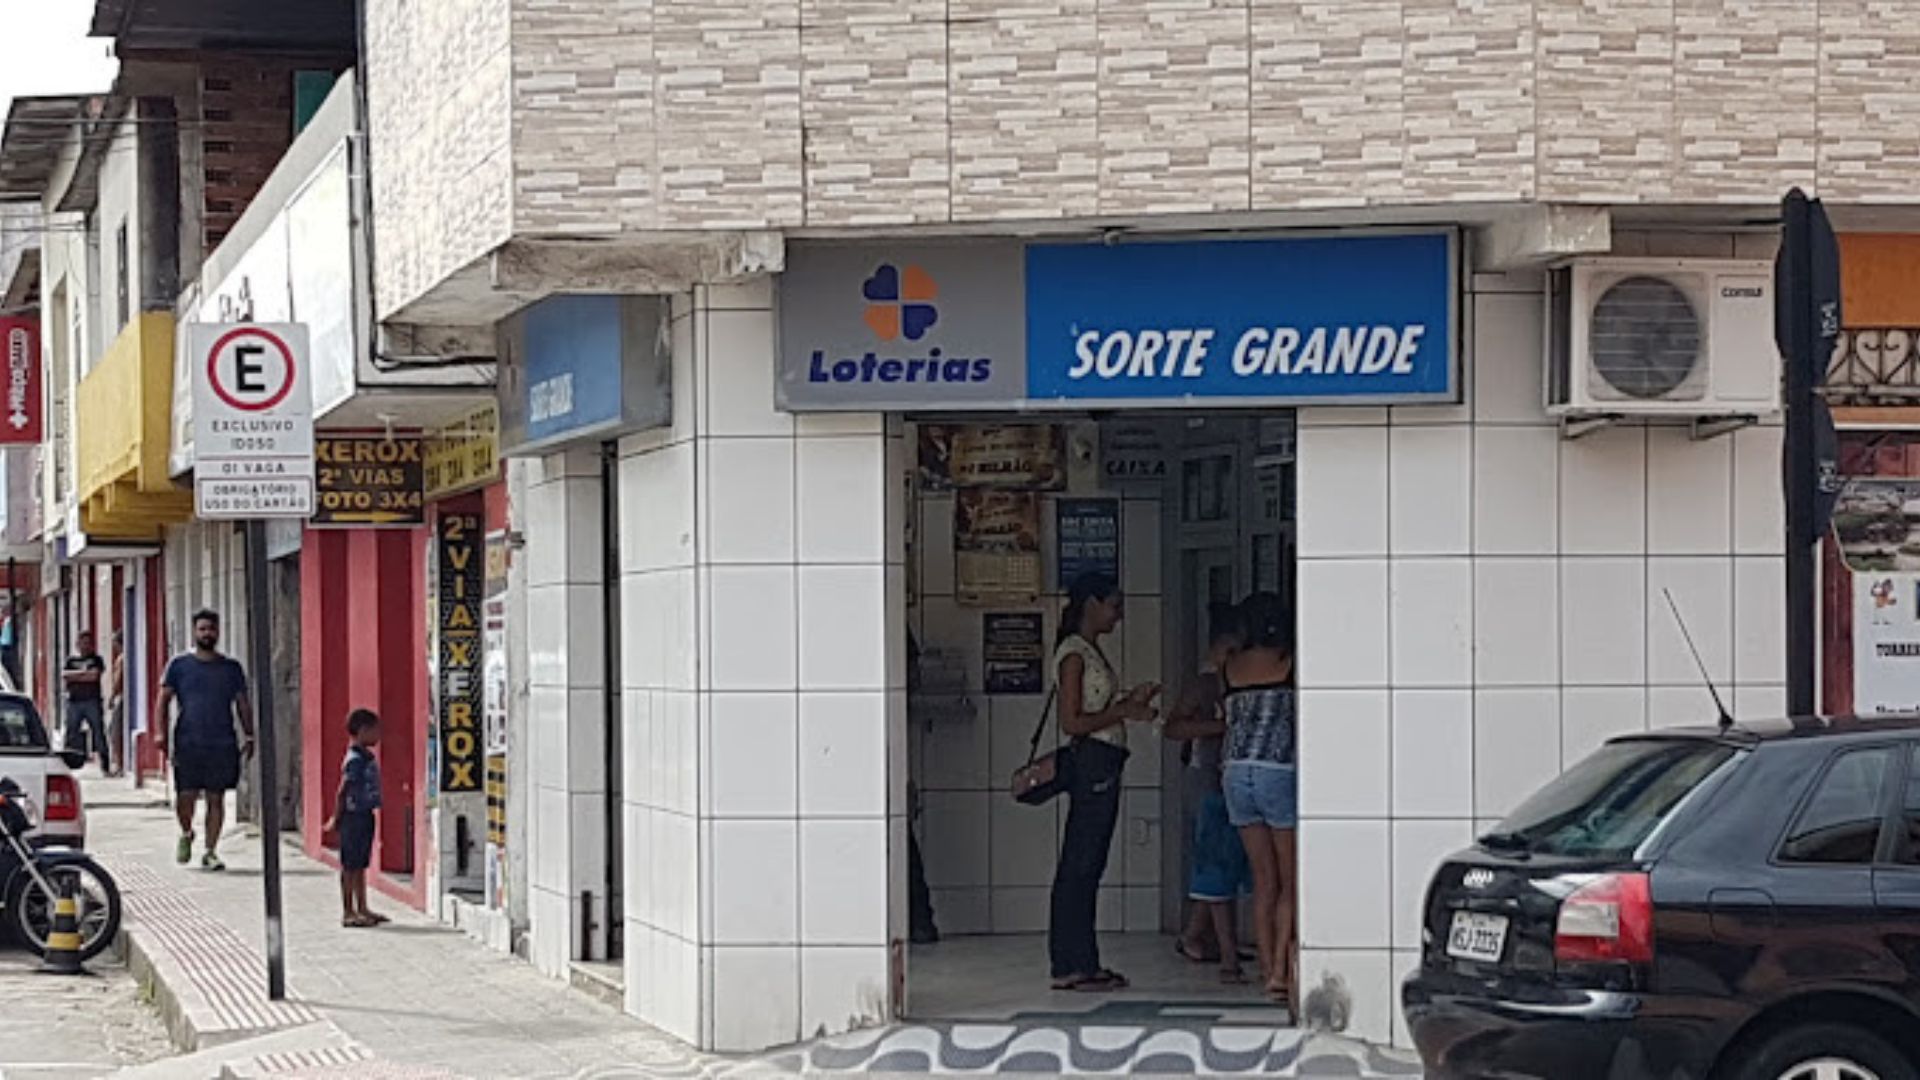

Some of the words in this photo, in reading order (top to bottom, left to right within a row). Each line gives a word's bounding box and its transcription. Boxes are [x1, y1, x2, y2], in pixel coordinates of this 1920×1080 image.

[1068, 328, 1215, 379] SORTE
[1231, 324, 1425, 376] GRANDE
[236, 346, 265, 392] E
[808, 347, 993, 383] Loterias
[212, 420, 293, 432] EXCLUSIVO
[231, 437, 275, 450] IDOSO
[316, 441, 421, 462] XEROX
[244, 462, 286, 473] VAGA
[349, 468, 404, 485] VIAS
[1106, 460, 1166, 475] CAIXA
[205, 498, 228, 509] USO
[379, 491, 421, 509] 3X4
[449, 545, 473, 626] VIA
[447, 640, 474, 788] XEROX
